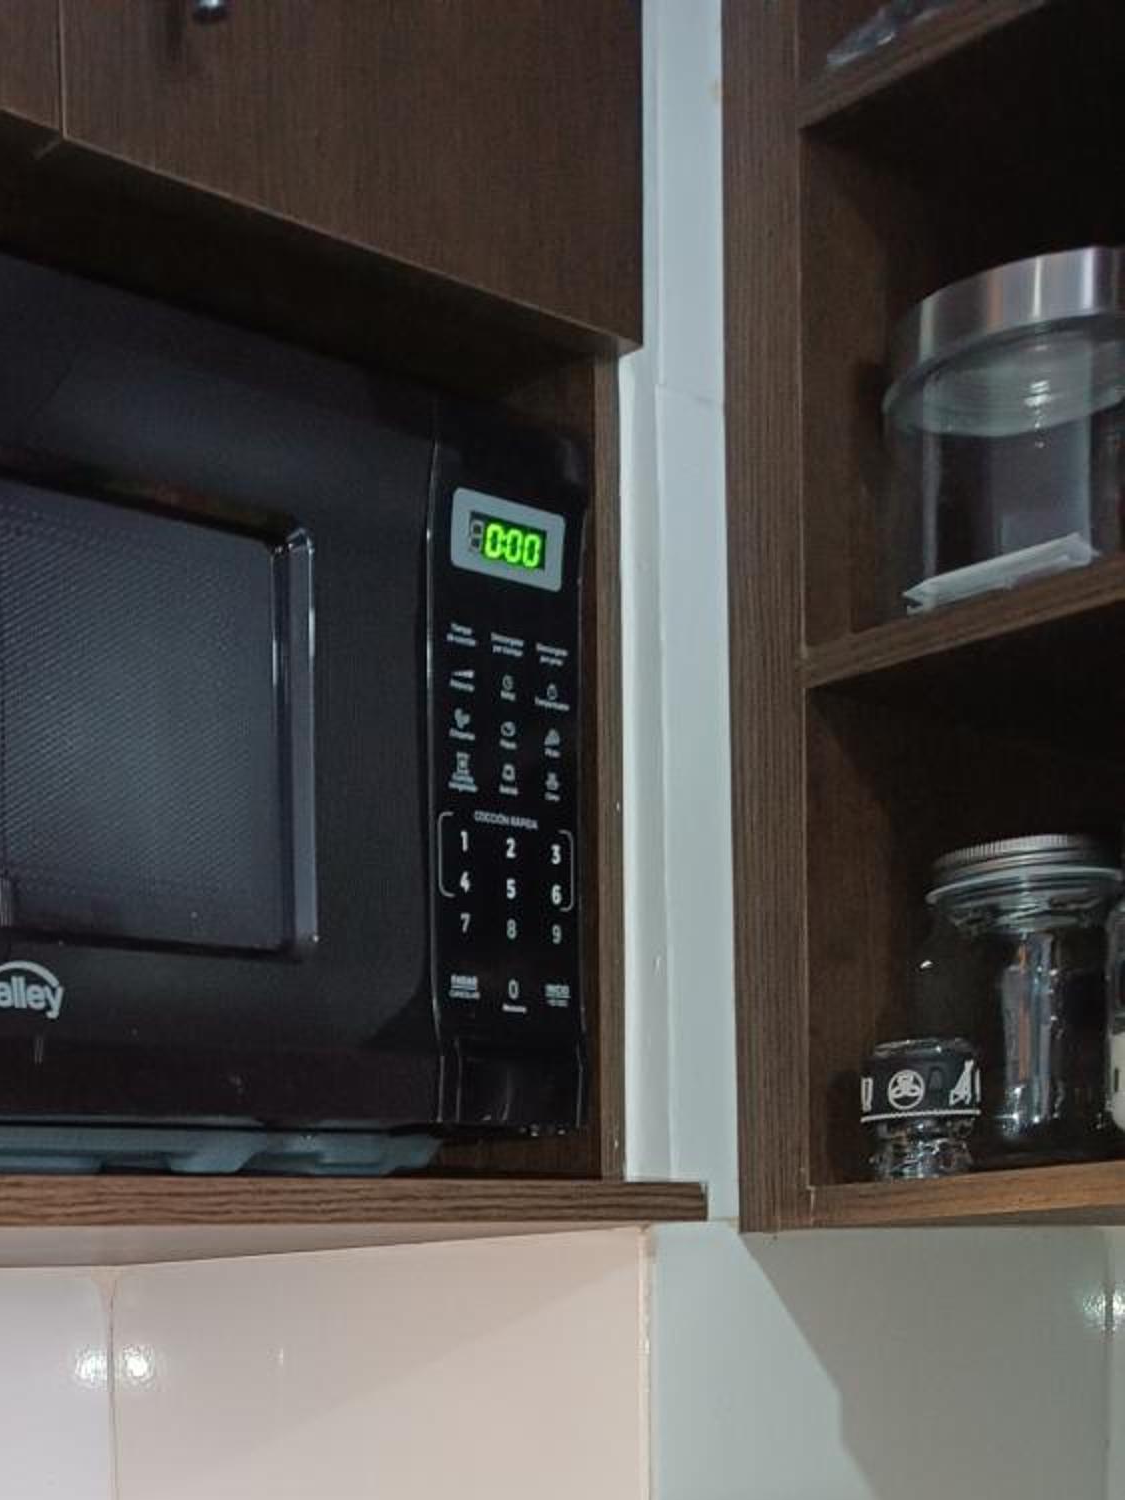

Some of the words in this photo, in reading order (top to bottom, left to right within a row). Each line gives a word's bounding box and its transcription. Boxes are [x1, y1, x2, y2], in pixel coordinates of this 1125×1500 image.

[484, 523, 542, 568] 0:00
[460, 830, 469, 852] 1
[506, 837, 517, 859] 2
[551, 844, 562, 865] 3
[459, 871, 471, 893] 4
[506, 878, 517, 900] 5
[551, 884, 562, 905] 6
[460, 912, 471, 933] 7
[506, 919, 517, 939] 8
[552, 924, 562, 944] 9
[508, 979, 519, 1000] 0
